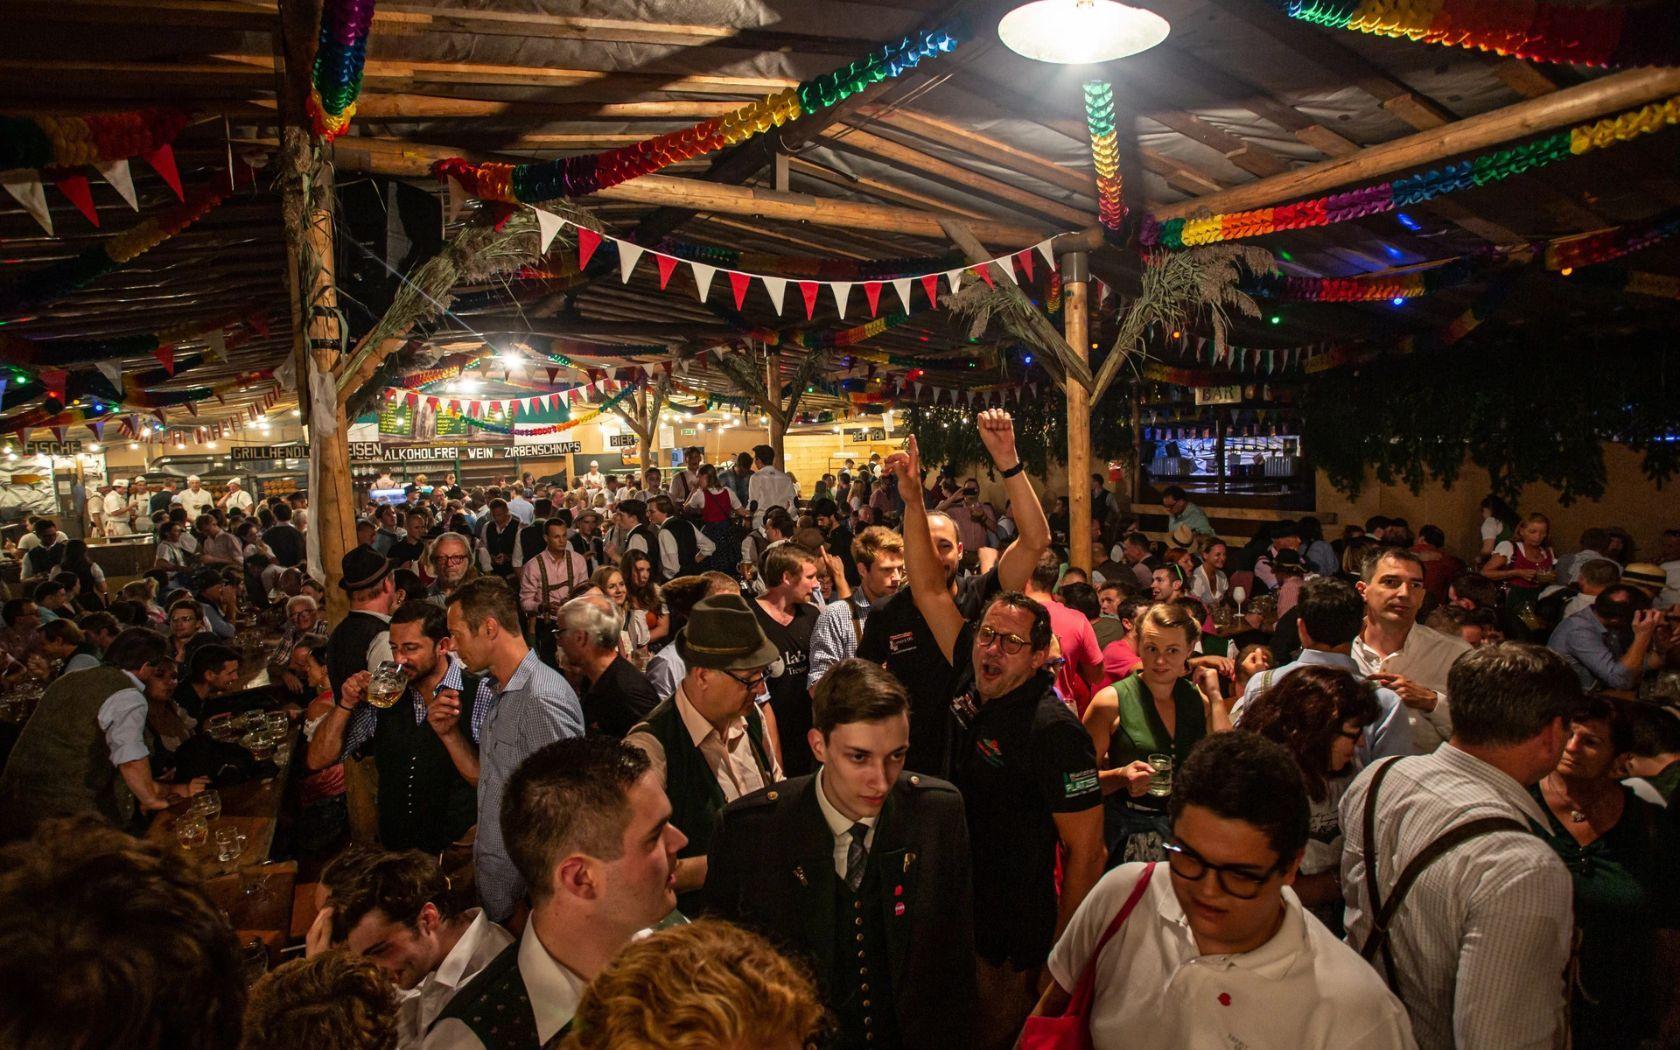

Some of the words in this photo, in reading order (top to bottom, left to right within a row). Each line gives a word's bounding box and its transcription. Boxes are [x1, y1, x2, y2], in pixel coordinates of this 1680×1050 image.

[1203, 384, 1233, 401] BAR
[611, 435, 633, 446] BIER
[24, 441, 81, 455] FISCHE
[233, 446, 309, 459] GRILLHENDL
[384, 447, 459, 460] ALKOHOLFREI
[467, 447, 494, 459] WEIN
[503, 441, 581, 458] ZIRBENSCHNAPS
